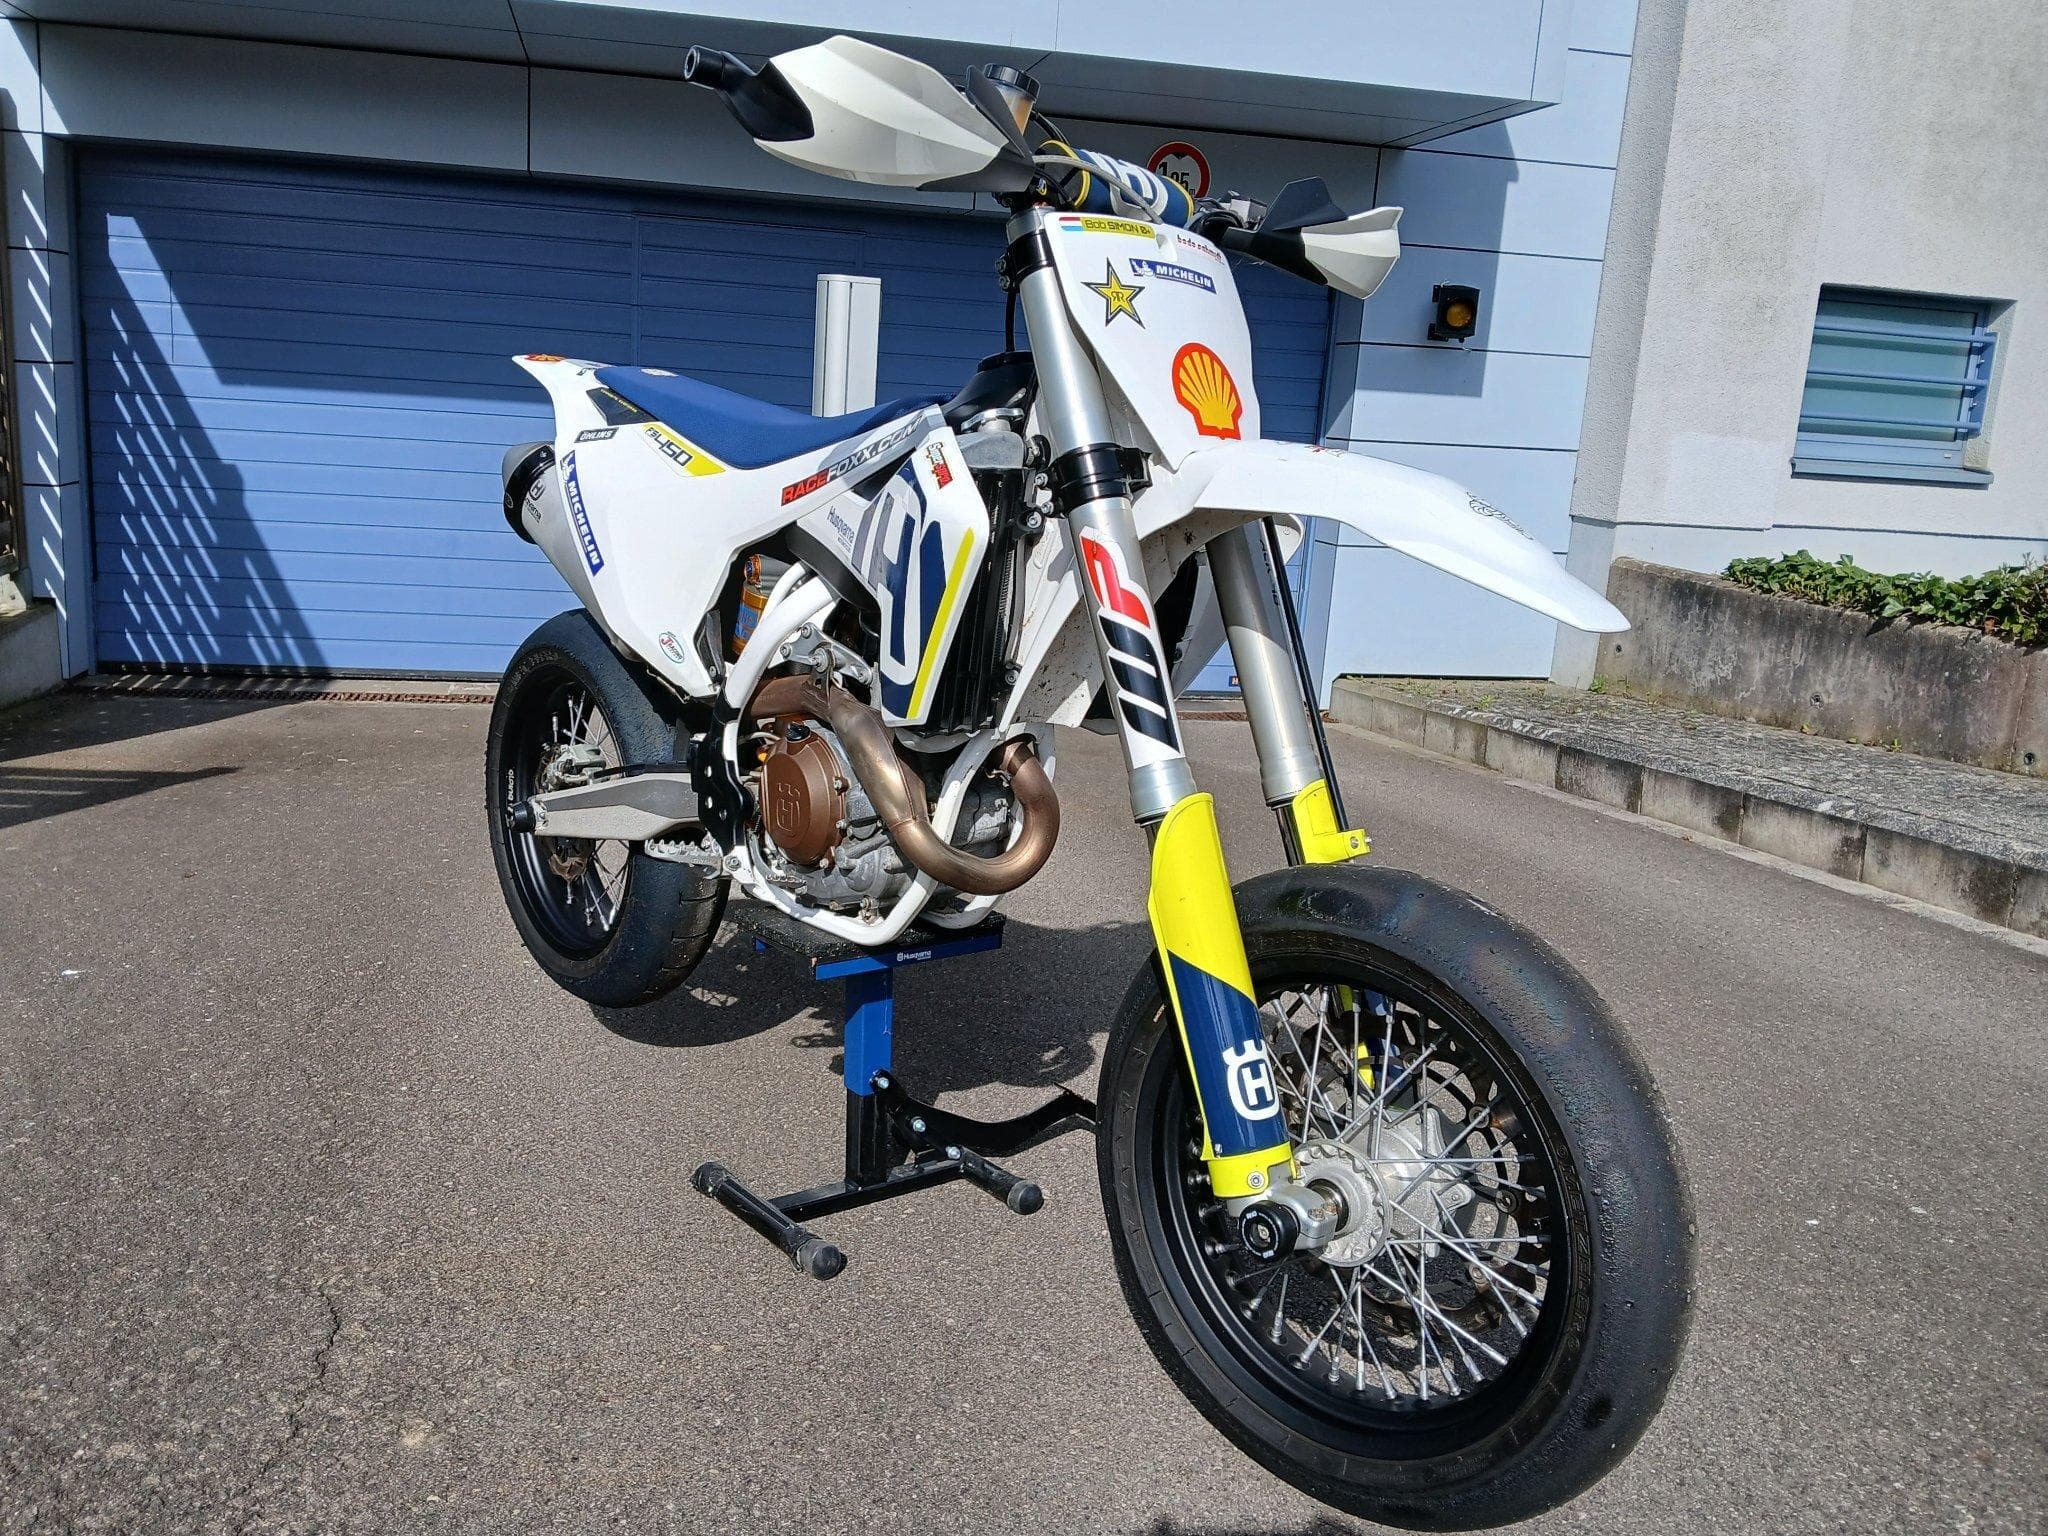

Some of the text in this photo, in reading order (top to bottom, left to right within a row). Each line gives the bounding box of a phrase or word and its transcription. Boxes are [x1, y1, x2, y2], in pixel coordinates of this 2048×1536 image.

[1107, 220, 1139, 233] SIMON
[1155, 264, 1213, 289] MICHELIN
[781, 411, 925, 506] RACEFOXX.COM
[567, 480, 601, 566] MICHELIN
